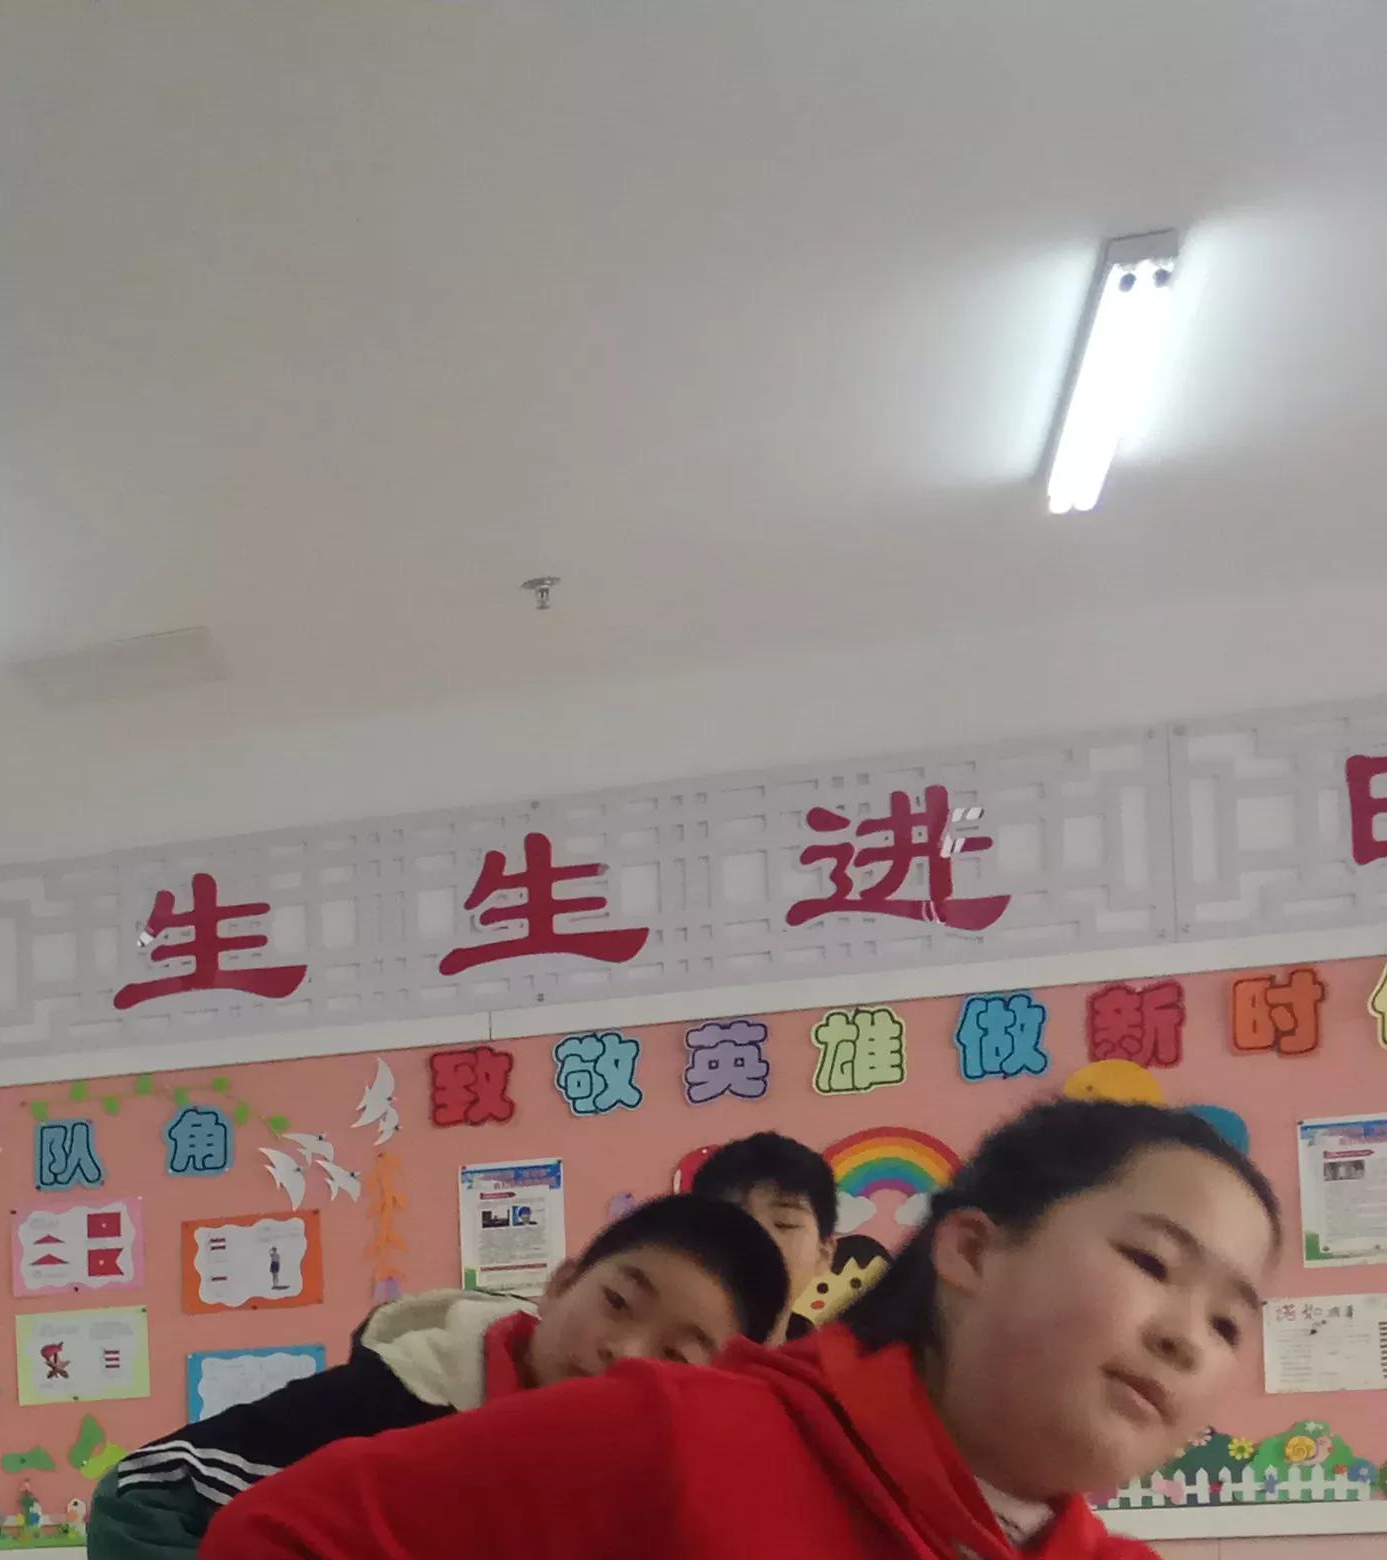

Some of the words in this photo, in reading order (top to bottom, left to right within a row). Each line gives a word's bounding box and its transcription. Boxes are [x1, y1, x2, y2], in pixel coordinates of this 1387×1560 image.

[429, 962, 1387, 1127] 致敬英雄做新时
[37, 1108, 230, 1190] 队角
